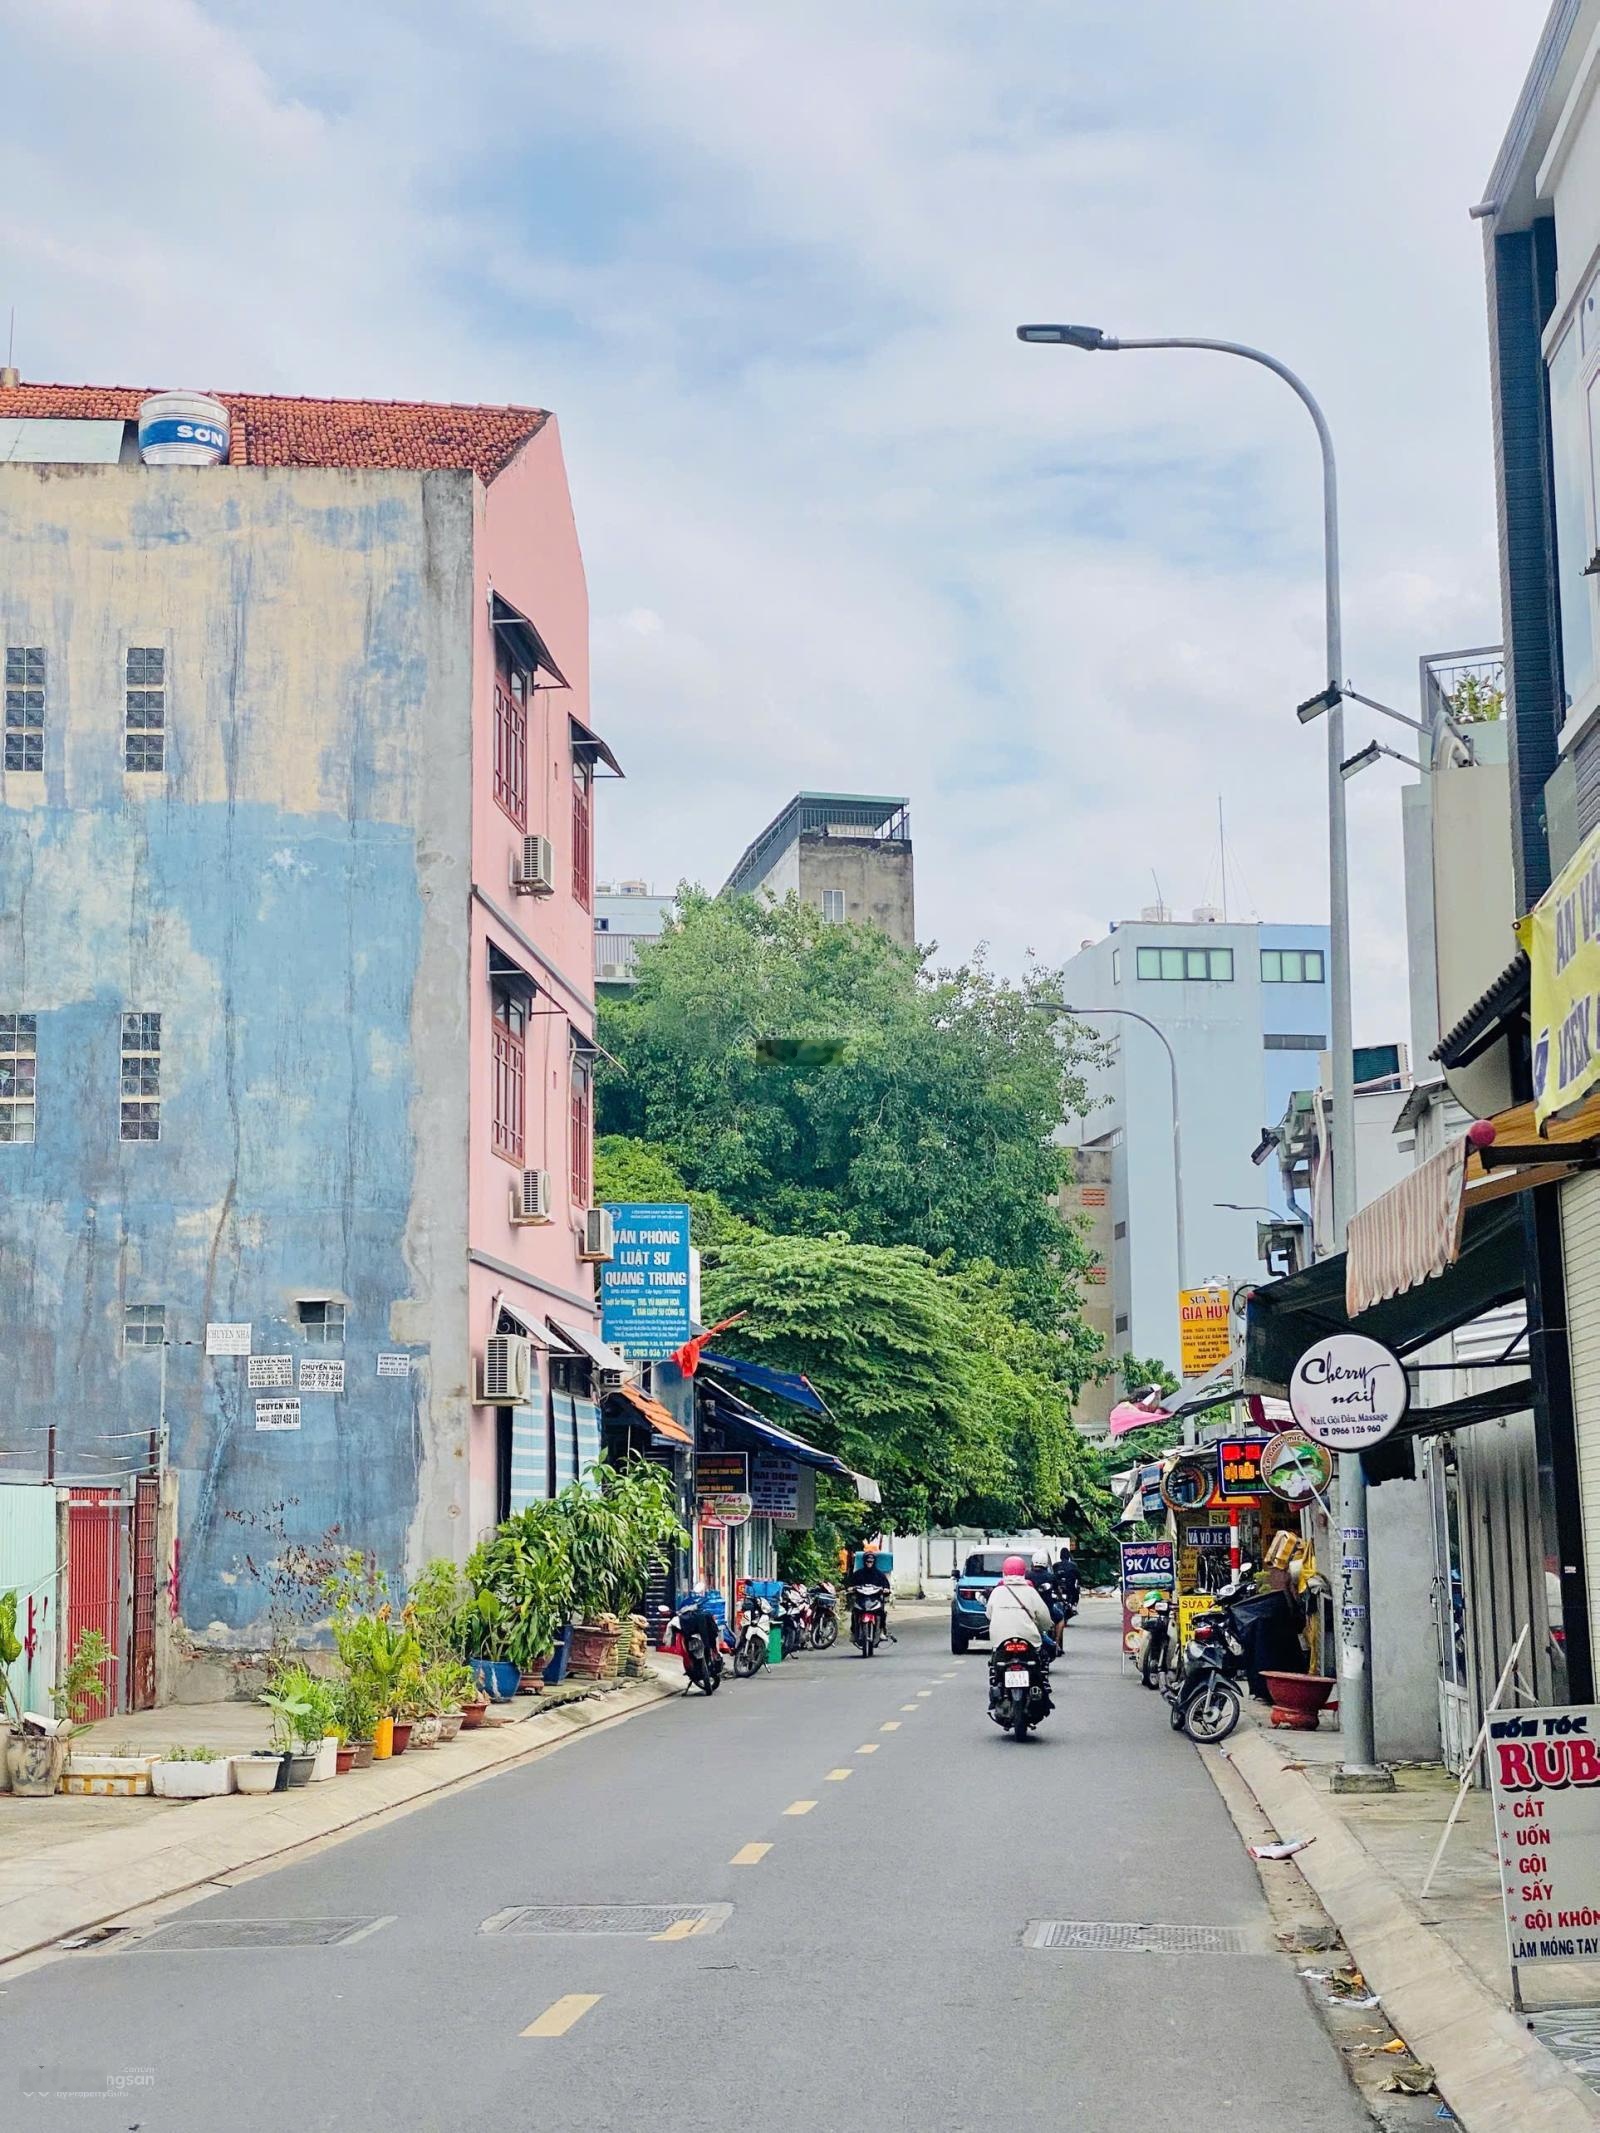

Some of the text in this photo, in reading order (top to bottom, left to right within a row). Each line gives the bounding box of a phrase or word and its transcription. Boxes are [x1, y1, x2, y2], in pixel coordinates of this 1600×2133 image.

[640, 1228, 680, 1245] PHÒNG
[620, 1249, 671, 1267] LUẬT SƯ
[605, 1271, 687, 1287] QUANG TRUNG
[1182, 1304, 1230, 1320] GIA HUY
[1300, 1350, 1391, 1389] Cherry
[1331, 1377, 1376, 1413] nail
[1358, 1413, 1389, 1423] Massage
[1331, 1424, 1381, 1436] 0966 126 960
[1188, 1531, 1199, 1544] VÁ
[1212, 1532, 1223, 1545] XE
[1125, 1557, 1171, 1572] 9K/KG
[1543, 1714, 1589, 1737] TÓC
[1513, 1795, 1545, 1818] CẮT
[1516, 1825, 1550, 1846] UỐN
[1519, 1854, 1547, 1878] GỘI
[1522, 1879, 1553, 1902] SẤY
[1524, 1908, 1552, 1932] GỘI
[1513, 1936, 1599, 1958] LÀM MÓNG TAY
